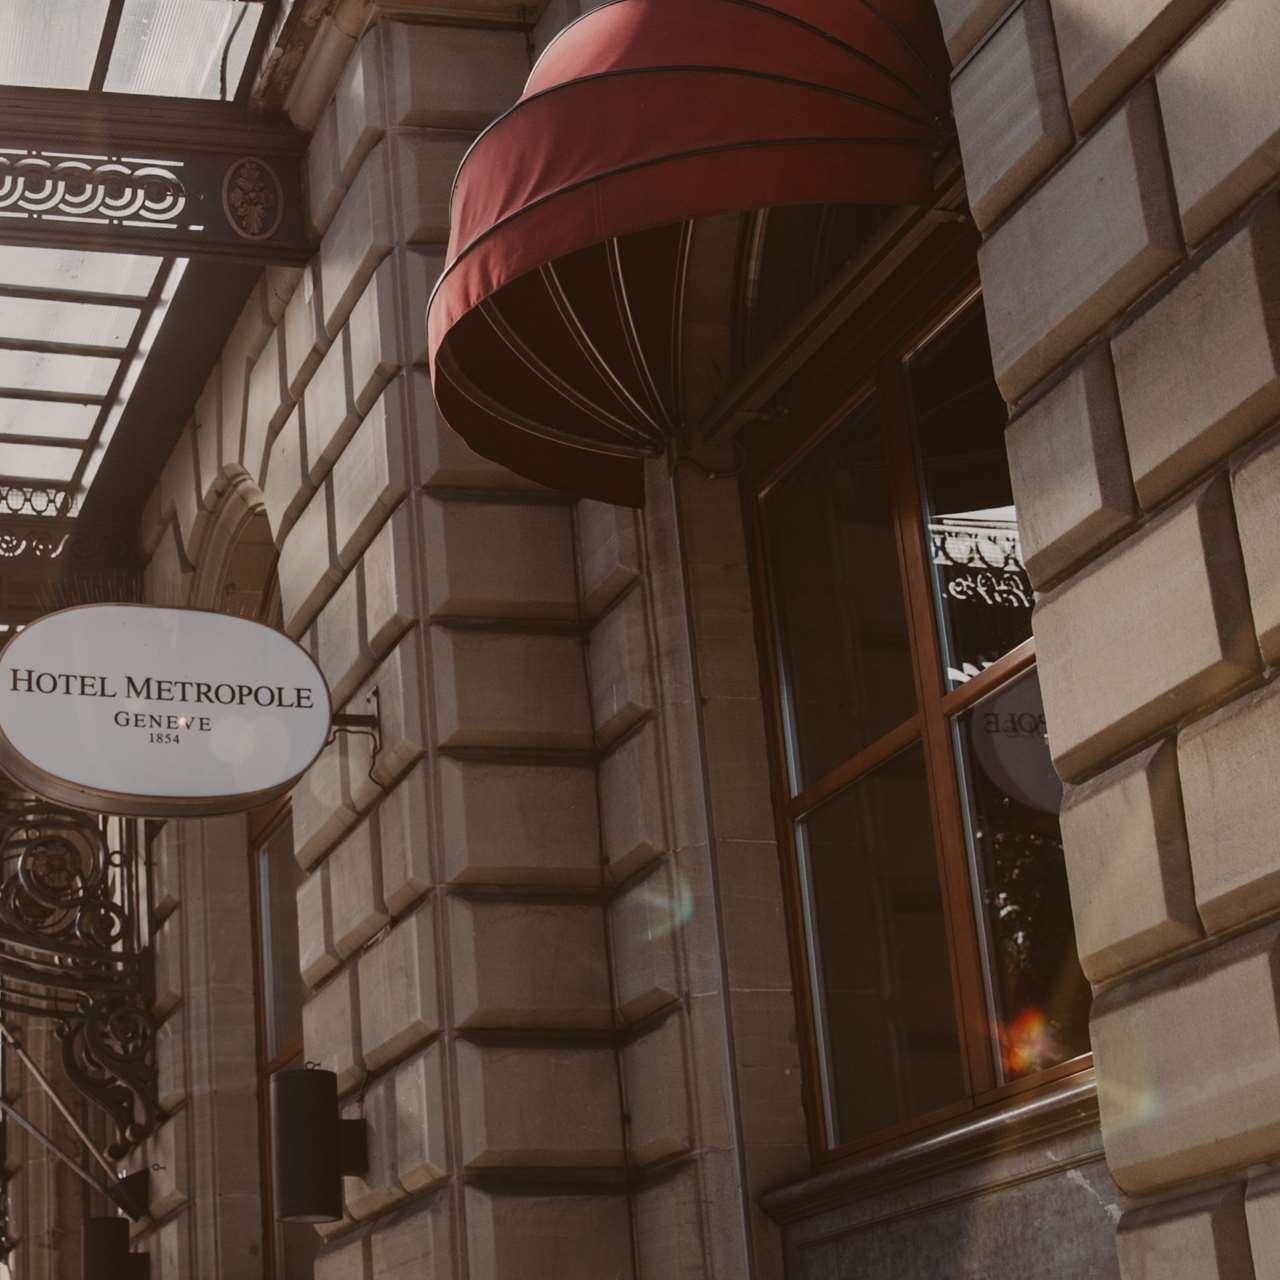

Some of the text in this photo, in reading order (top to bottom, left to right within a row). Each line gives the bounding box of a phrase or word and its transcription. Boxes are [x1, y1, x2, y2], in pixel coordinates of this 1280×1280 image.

[10, 668, 314, 708] HOTEL METROPOLE
[149, 732, 180, 745] 1854
